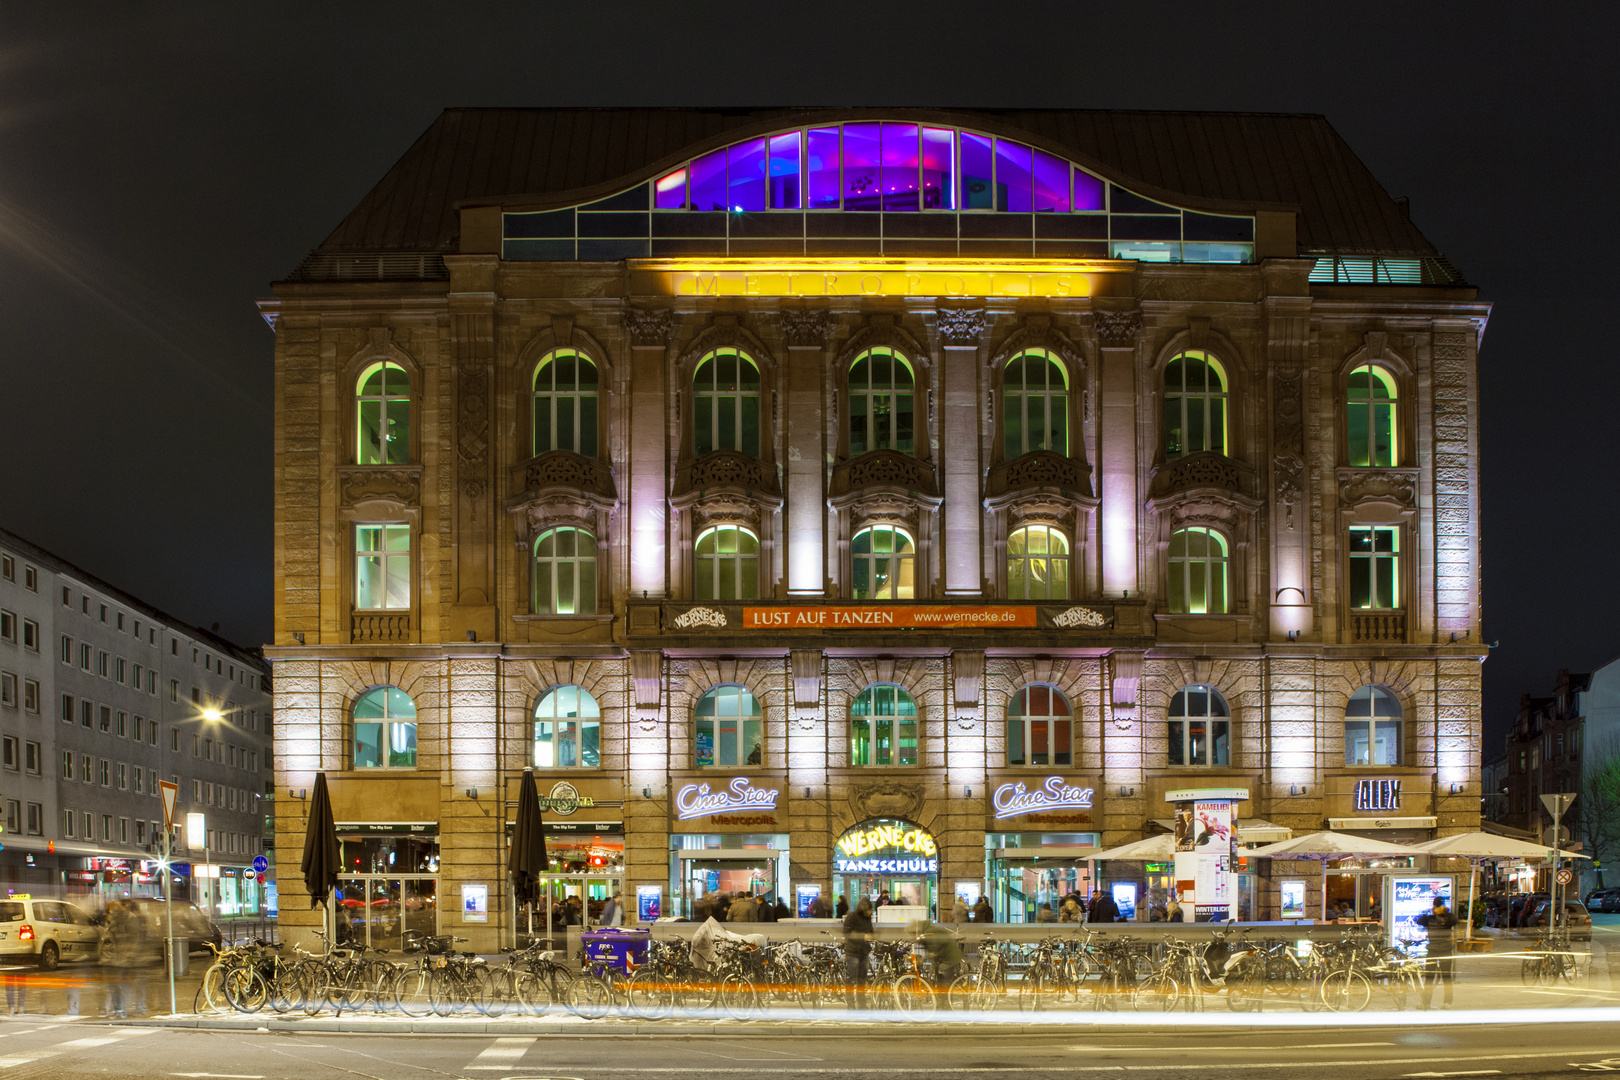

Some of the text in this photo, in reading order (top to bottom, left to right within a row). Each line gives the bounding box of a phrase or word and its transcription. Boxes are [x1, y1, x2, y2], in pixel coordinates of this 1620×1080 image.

[693, 272, 1072, 296] METROPOLIS
[674, 610, 727, 628] WERNECKE
[754, 610, 1016, 625] LUST AUF TANZEN www.wernecke.de
[1052, 609, 1105, 628] WERNECKE
[1356, 780, 1401, 810] ALEX
[1196, 803, 1230, 811] KAMELIEN
[837, 826, 936, 858] WERNECKE
[837, 859, 937, 872] TANZSCHULE
